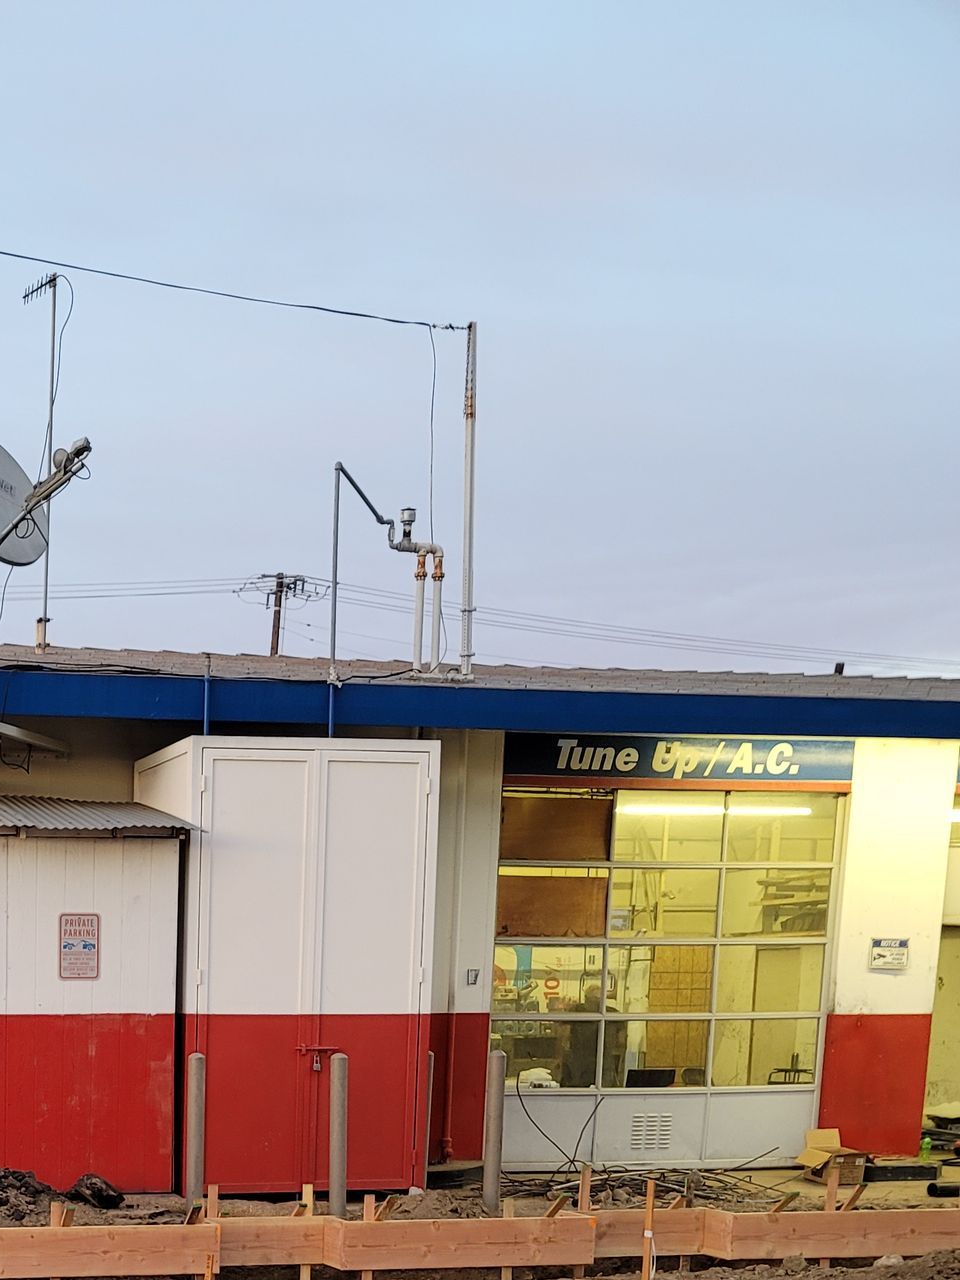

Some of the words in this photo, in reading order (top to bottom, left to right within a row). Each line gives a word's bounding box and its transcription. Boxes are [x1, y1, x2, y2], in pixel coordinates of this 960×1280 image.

[556, 738, 640, 772] Tune
[651, 740, 698, 780] Up
[726, 742, 800, 774] A.C.
[65, 917, 94, 928] PRIVATE
[64, 929, 96, 938] PARKING
